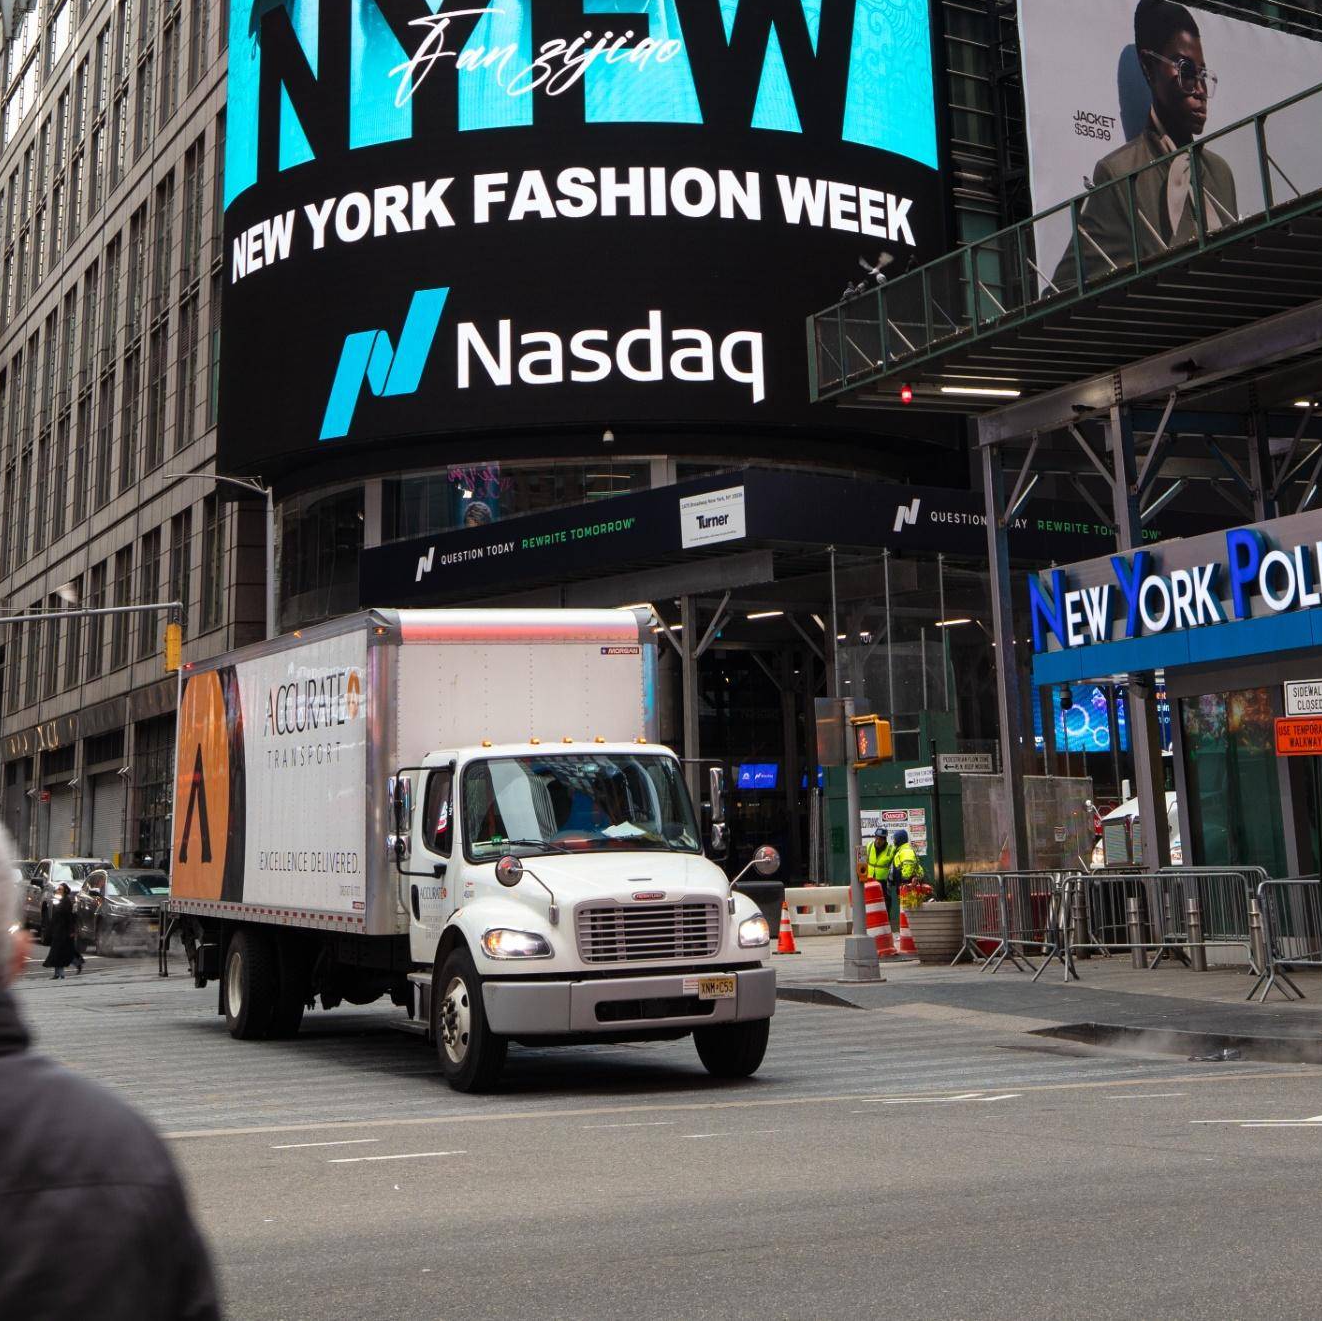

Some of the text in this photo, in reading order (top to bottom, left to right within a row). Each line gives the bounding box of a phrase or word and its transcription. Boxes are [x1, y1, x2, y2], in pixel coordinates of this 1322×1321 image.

[1073, 109, 1116, 129] JACKET
[1074, 123, 1111, 142] $35.99
[232, 167, 916, 284] NEW YORK FASHION WEEK
[457, 310, 766, 404] Nasdaq
[696, 513, 729, 529] Turner
[930, 511, 987, 526] QUESTION
[1037, 520, 1089, 534] REWRITE
[441, 547, 483, 565] QUESTION
[487, 541, 515, 556] TODAY
[522, 531, 567, 549] REWRITE
[1028, 569, 1114, 654] NEW
[1110, 550, 1225, 637] YORK
[263, 672, 345, 737] ACCURATE
[1278, 726, 1290, 736] USE
[1289, 737, 1322, 747] WALKWAY
[267, 741, 341, 769] TRANSPORT
[886, 811, 904, 819] DANGER
[259, 851, 307, 871] EXCELLENCE
